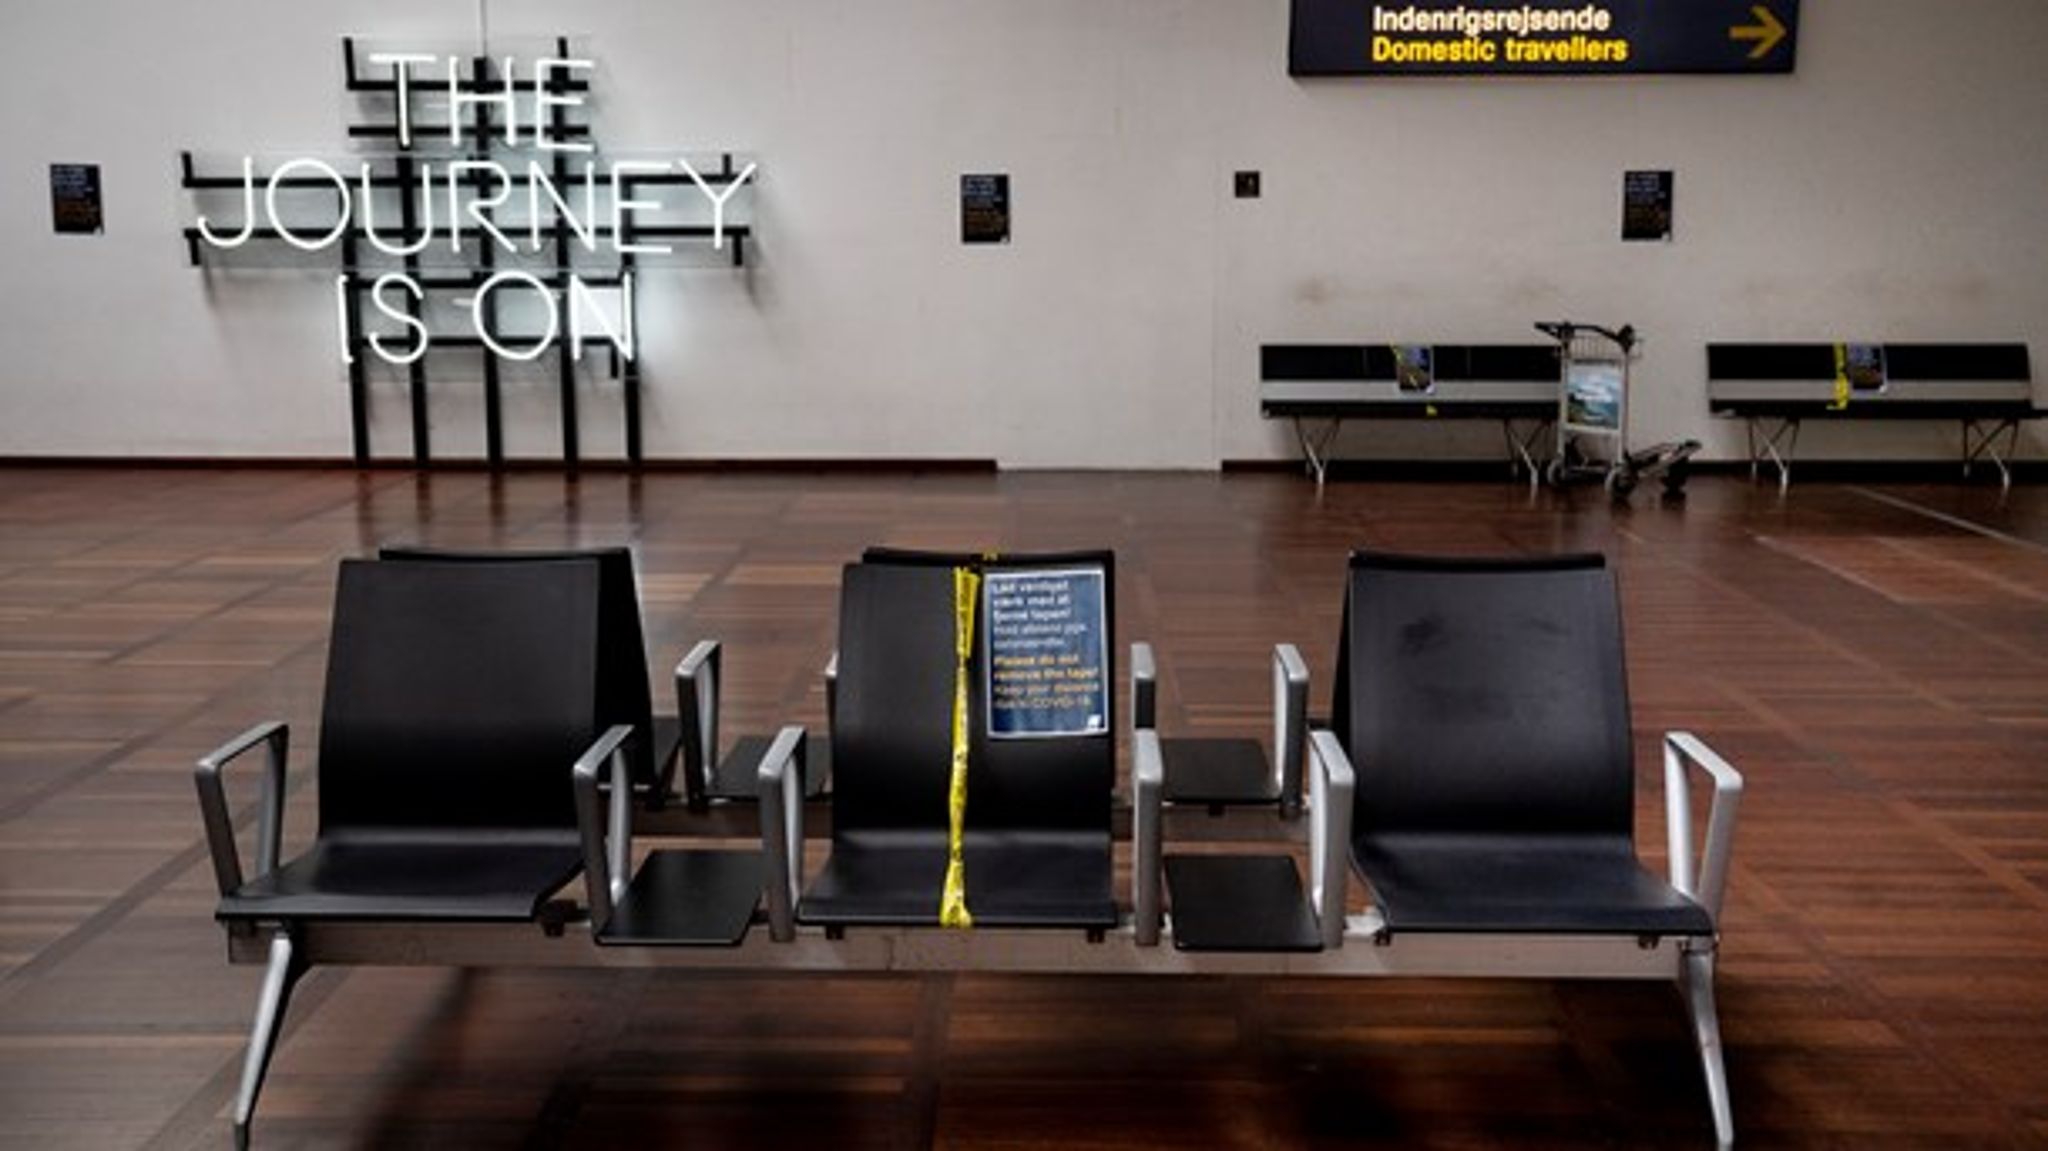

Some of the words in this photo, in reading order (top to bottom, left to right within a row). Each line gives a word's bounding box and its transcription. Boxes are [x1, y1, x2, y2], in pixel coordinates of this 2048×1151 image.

[1372, 35, 1496, 62] Domestic
[1505, 35, 1628, 62] travellers
[1373, 4, 1611, 37] Indenrigsrejsende
[368, 52, 594, 152] THE
[196, 156, 757, 255] JOURNEY
[338, 273, 428, 363] IS
[472, 269, 633, 361] ON
